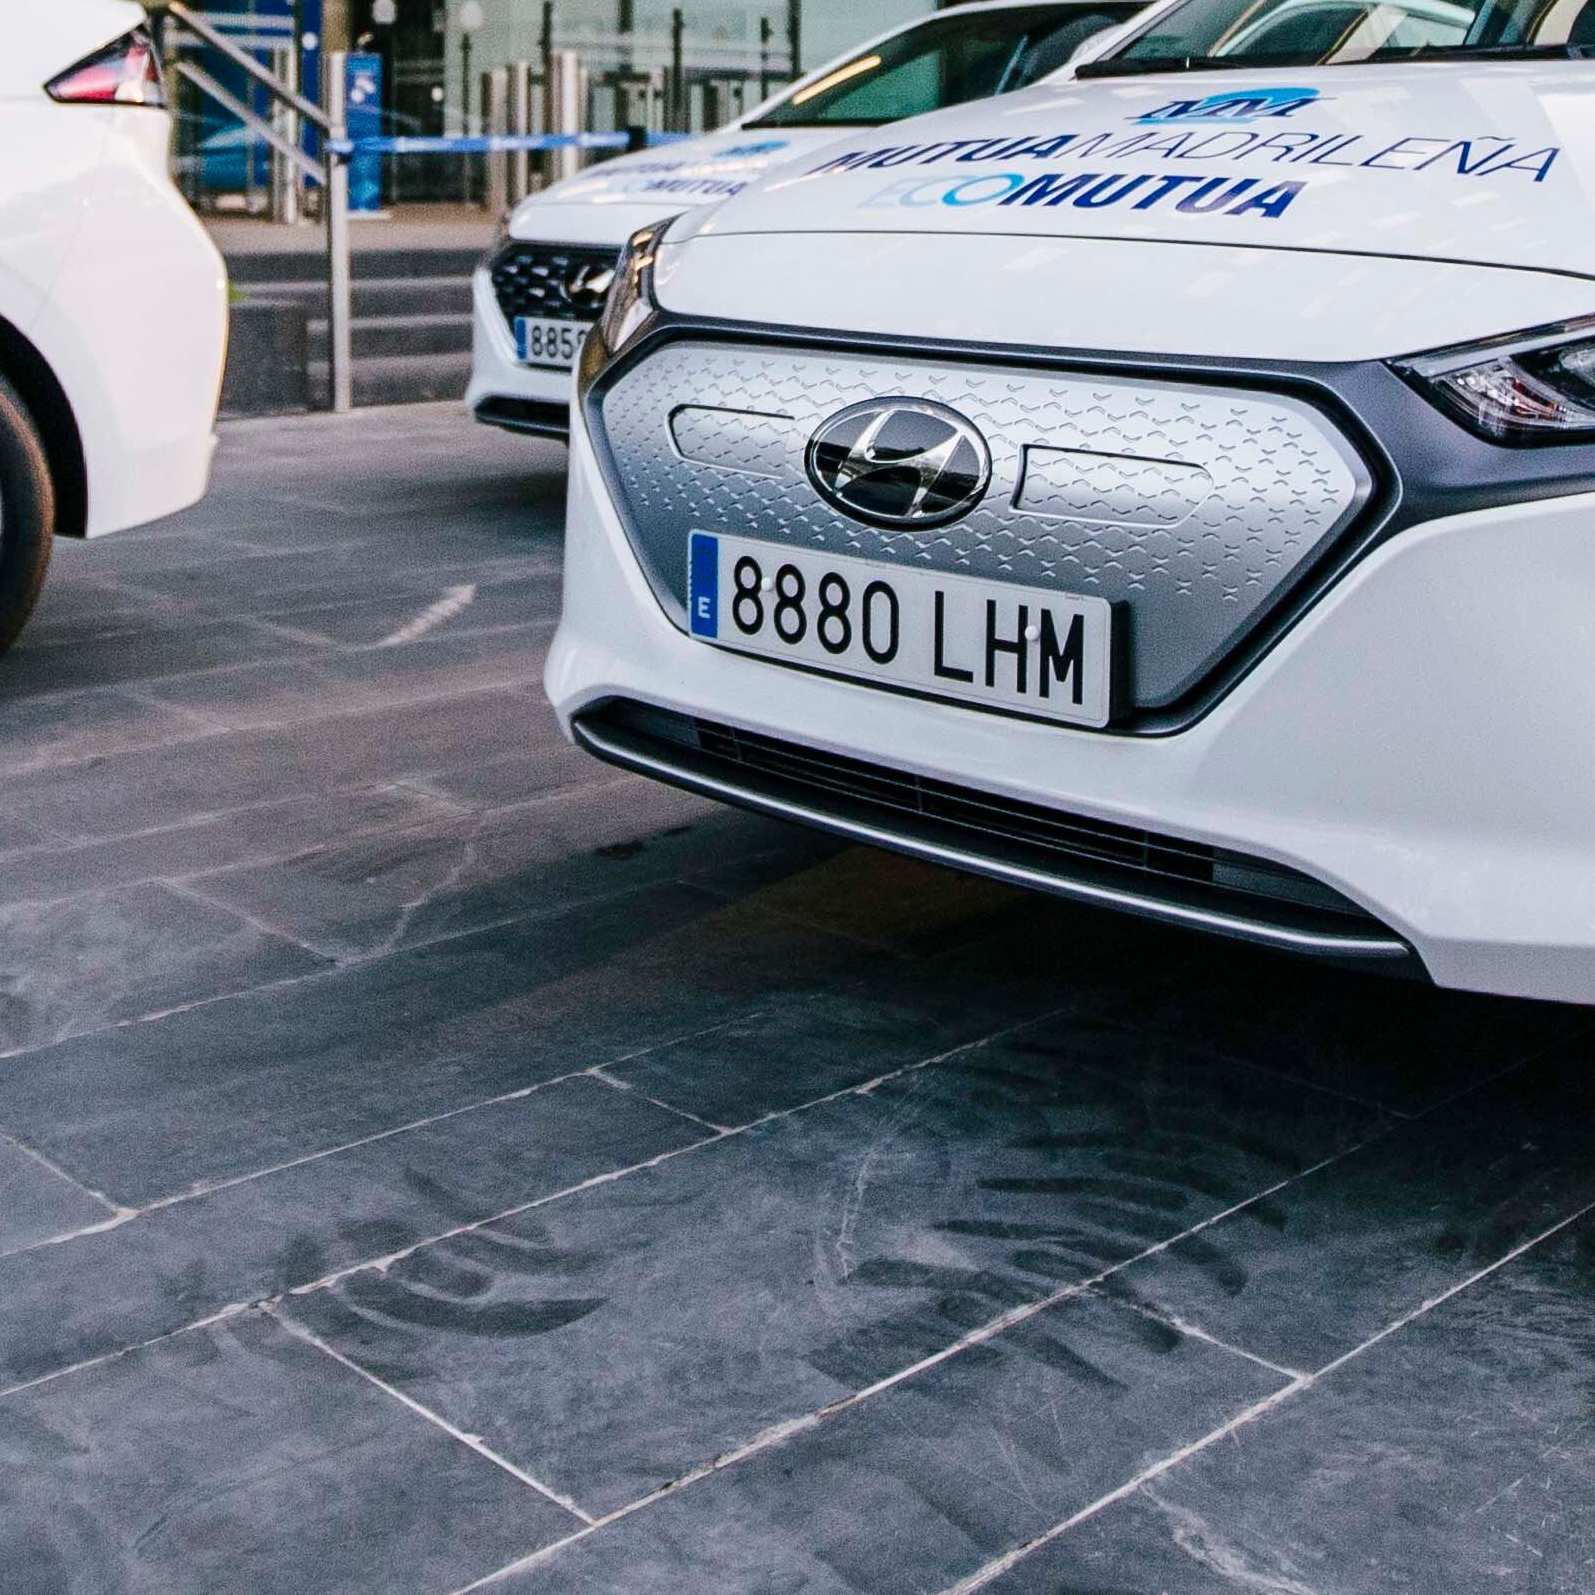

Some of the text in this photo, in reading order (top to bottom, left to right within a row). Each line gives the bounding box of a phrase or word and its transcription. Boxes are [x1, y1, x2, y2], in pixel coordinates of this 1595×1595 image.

[697, 554, 1085, 706] E 8880 LHM
